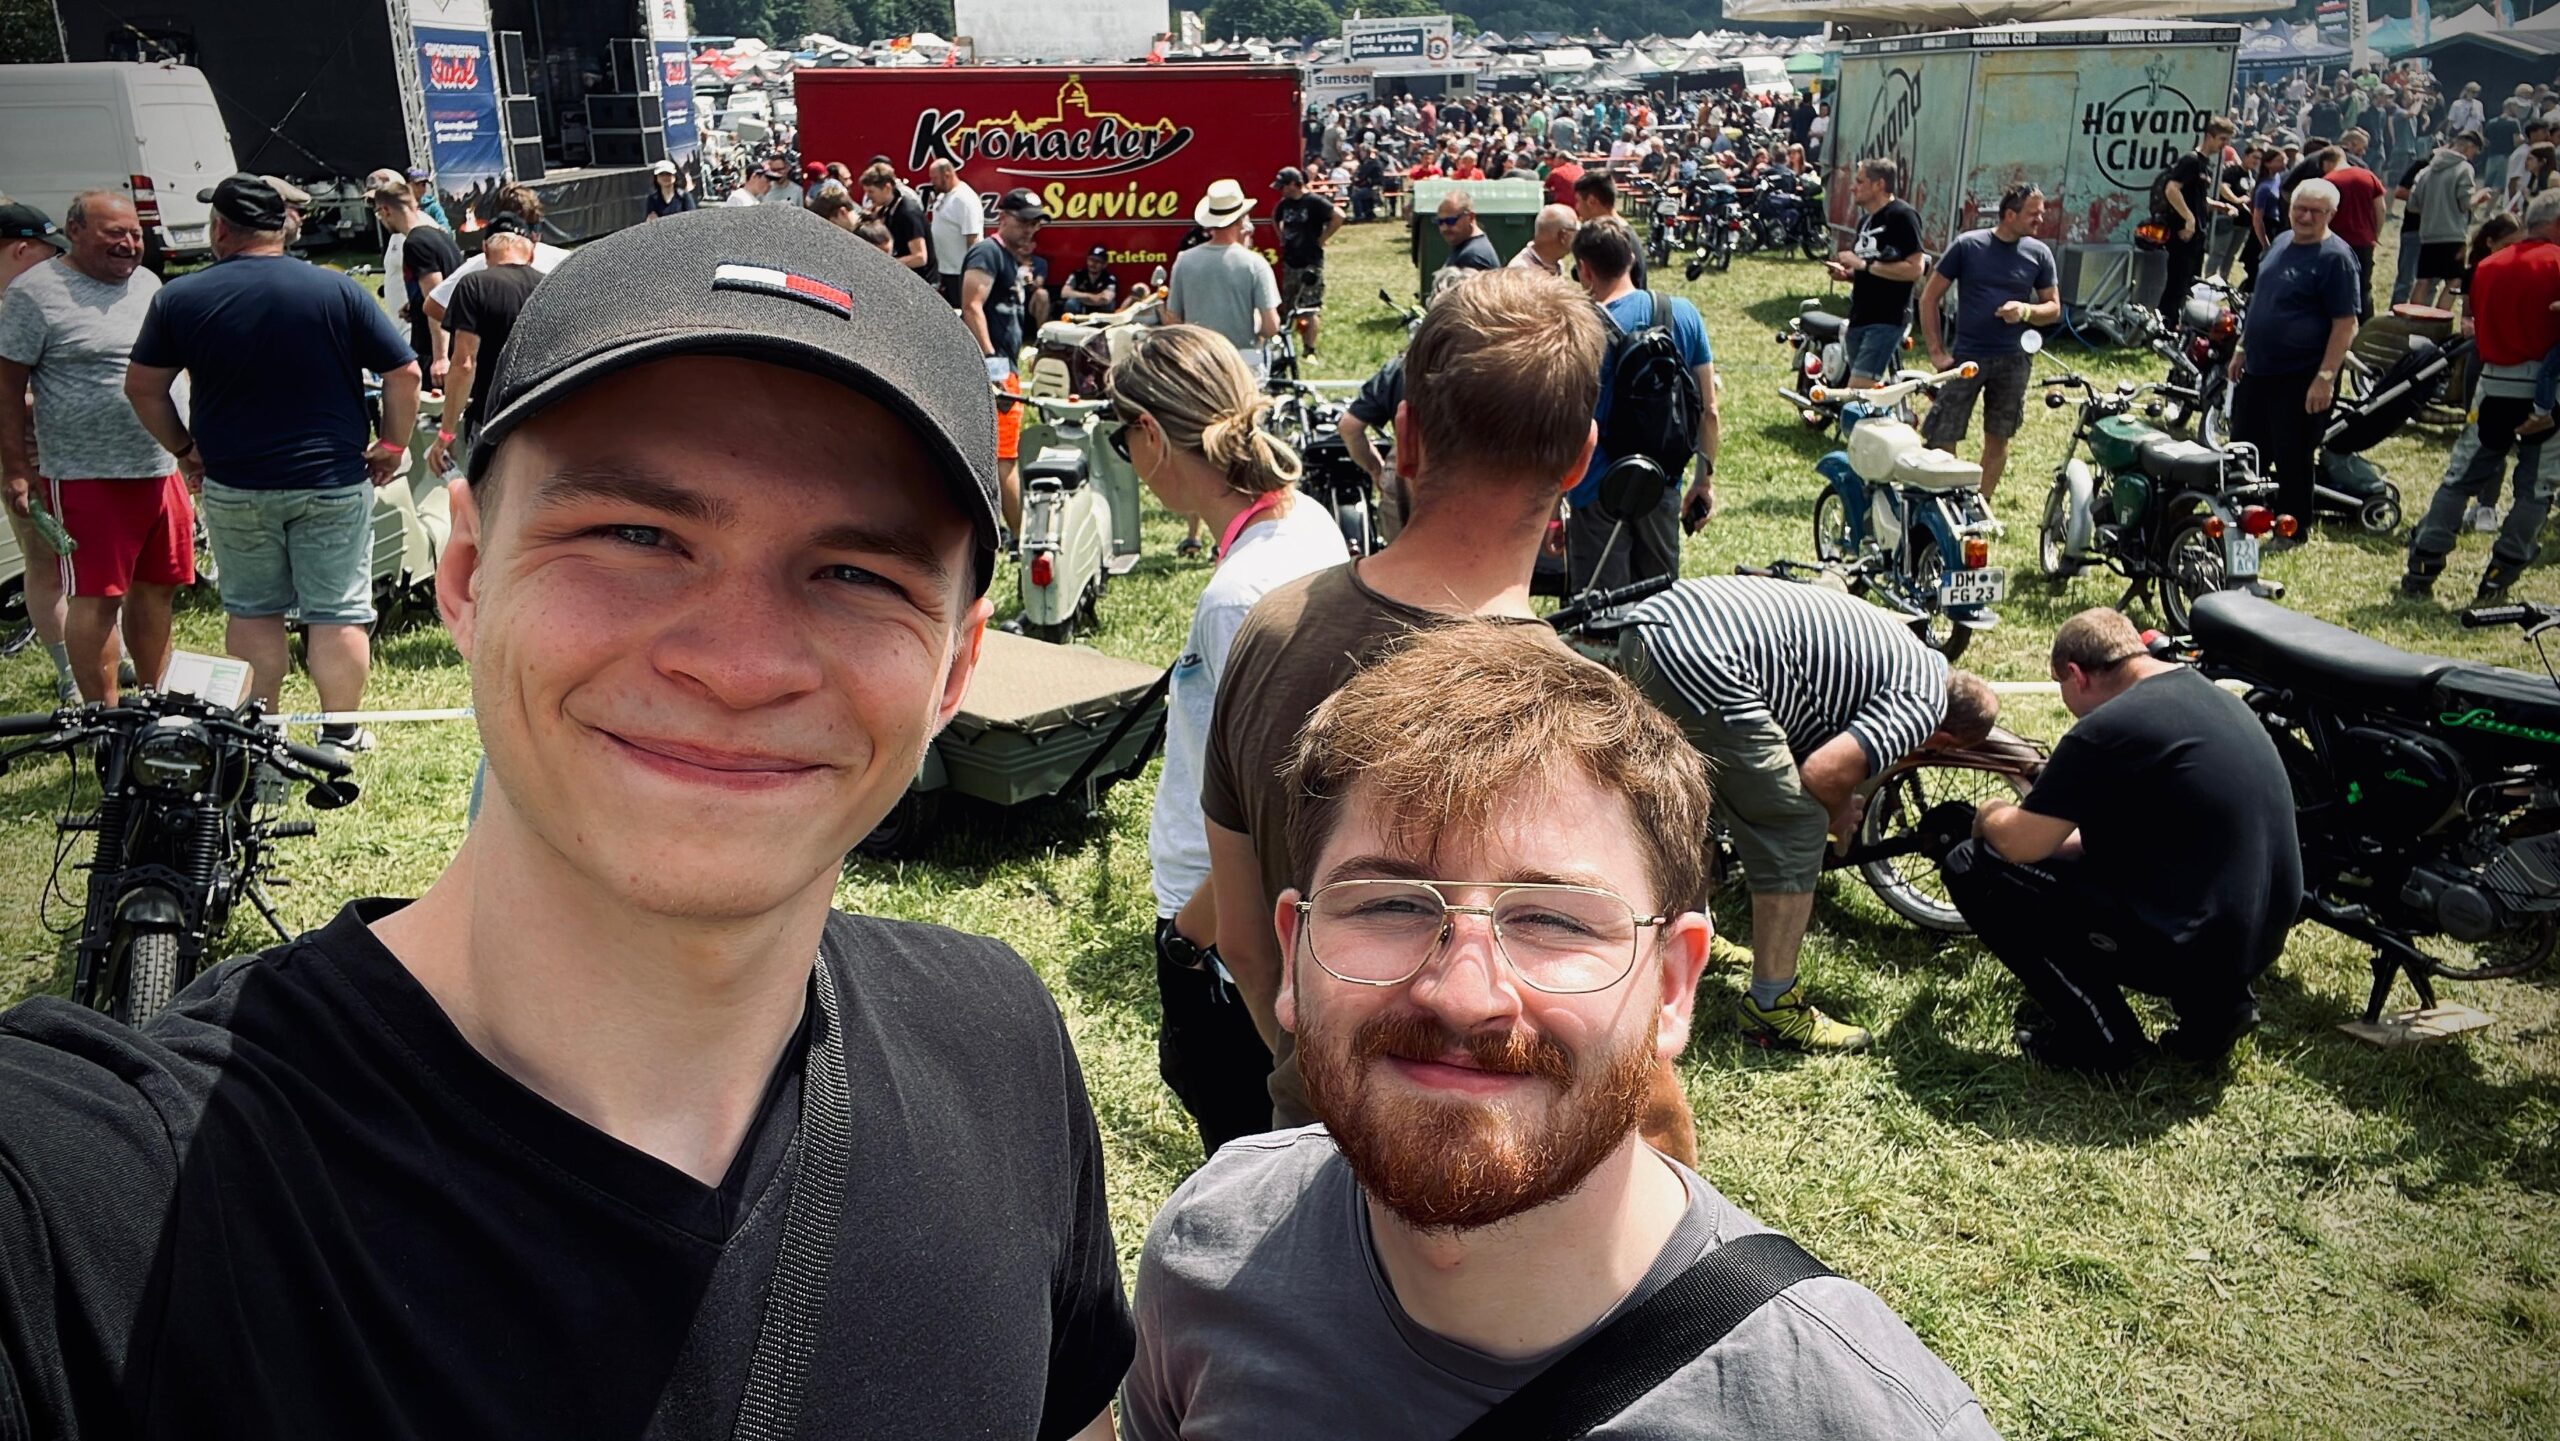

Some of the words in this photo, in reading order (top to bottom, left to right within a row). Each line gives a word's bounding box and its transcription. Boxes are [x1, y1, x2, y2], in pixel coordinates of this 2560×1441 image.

[2012, 31, 2037, 44] CLUB
[2147, 29, 2173, 42] CLUB
[1315, 74, 1371, 85] simson
[2082, 102, 2212, 135] Havana
[909, 108, 1190, 175] Kronacher
[2107, 138, 2179, 170] Club
[1042, 181, 1178, 219] Service
[1106, 250, 1167, 264] Telefon
[1955, 572, 1975, 587] DM
[1950, 588, 1970, 603] FG
[1975, 586, 1995, 601] 23
